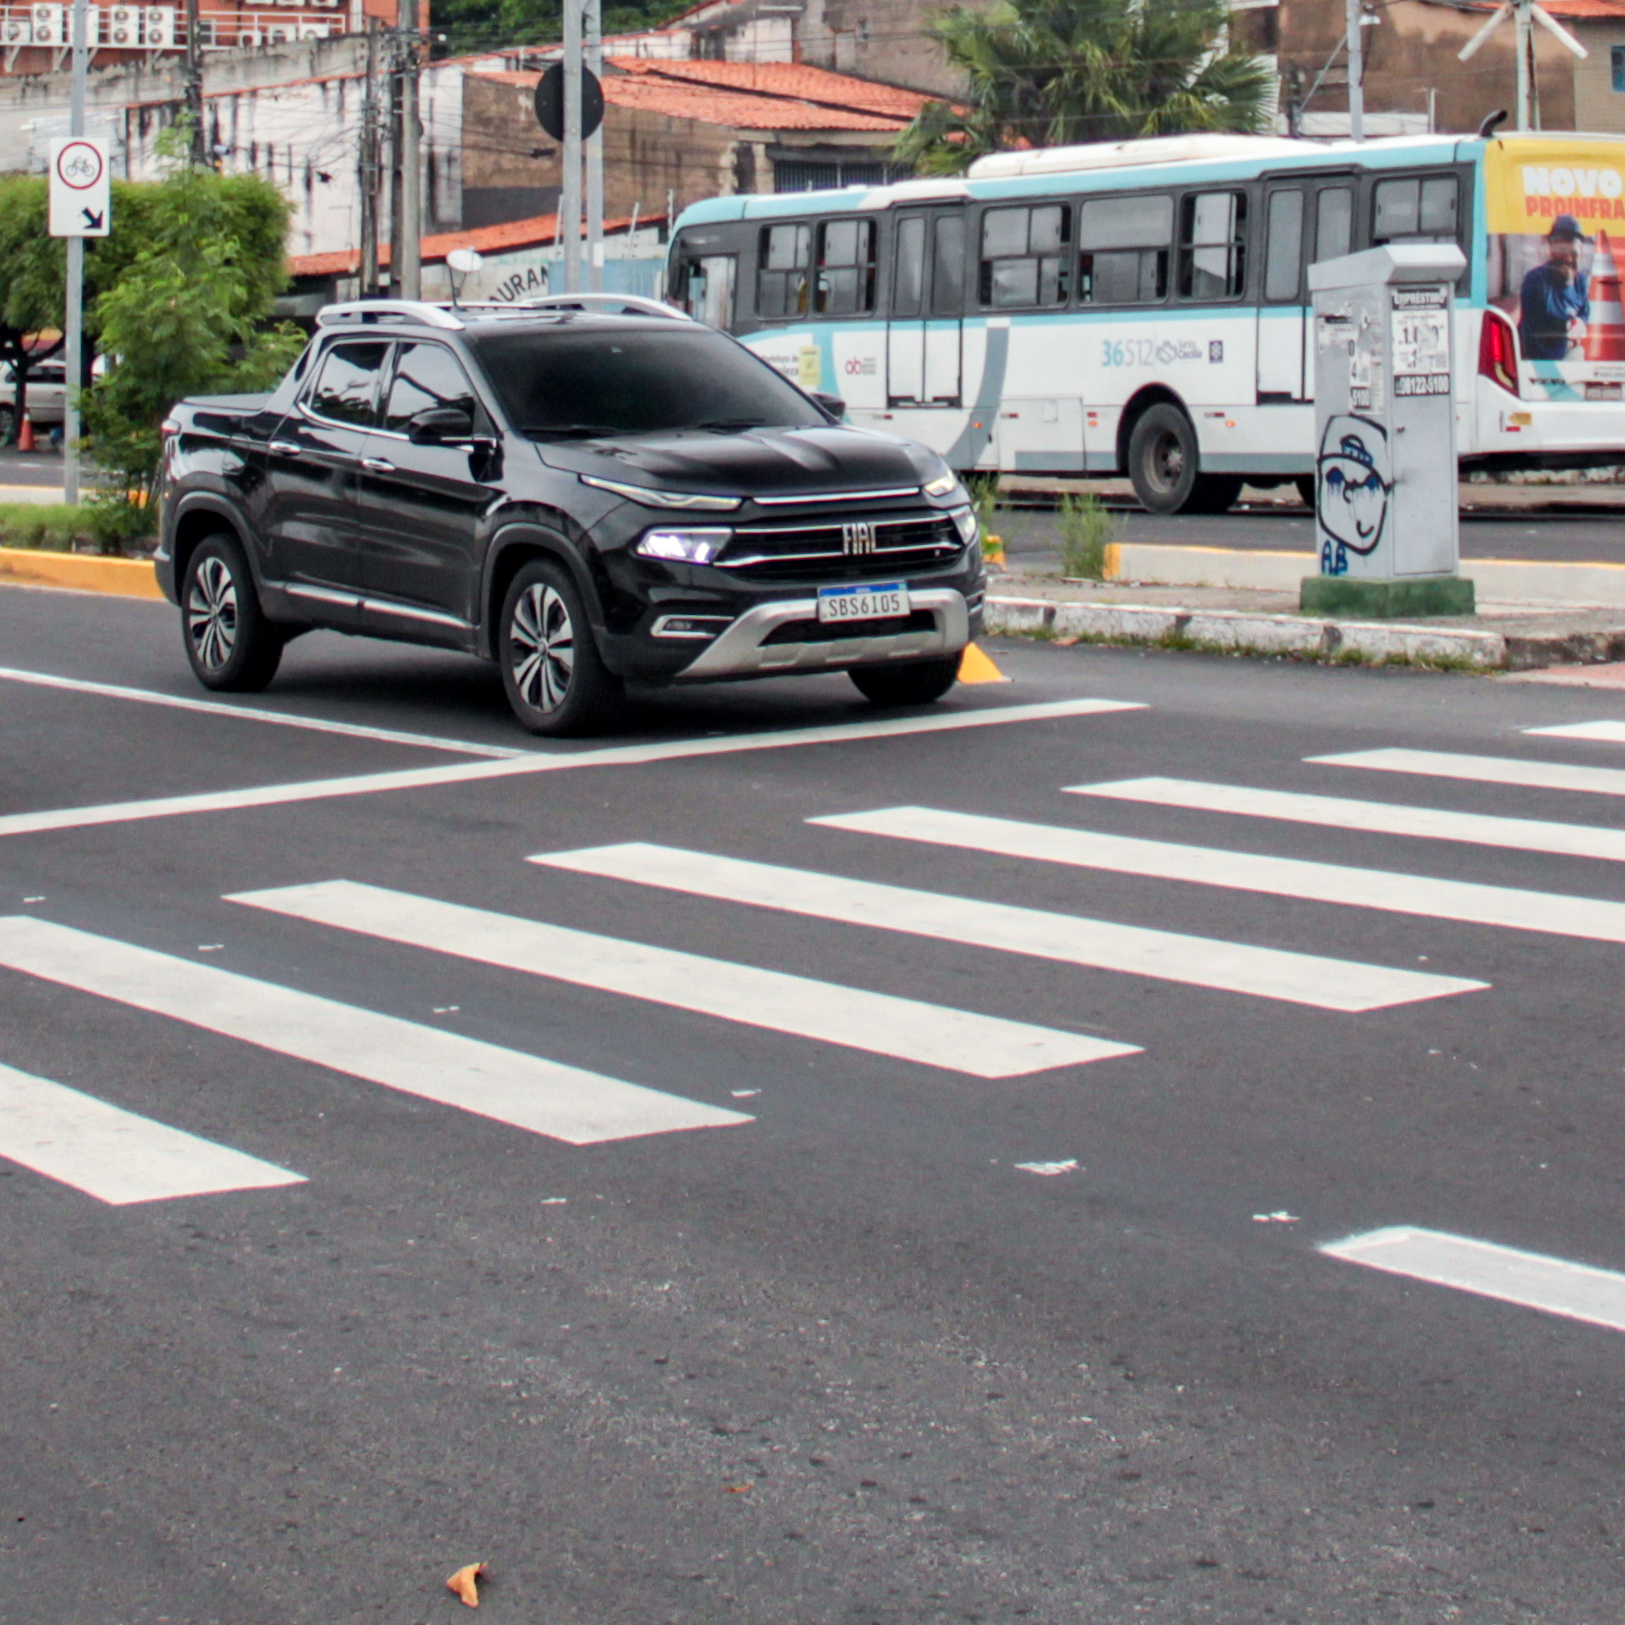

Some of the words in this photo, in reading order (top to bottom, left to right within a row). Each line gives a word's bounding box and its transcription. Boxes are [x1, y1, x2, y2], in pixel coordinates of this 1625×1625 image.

[1521, 166, 1624, 198] NOVO
[1101, 339, 1154, 367] 36512
[841, 522, 877, 555] FIAT
